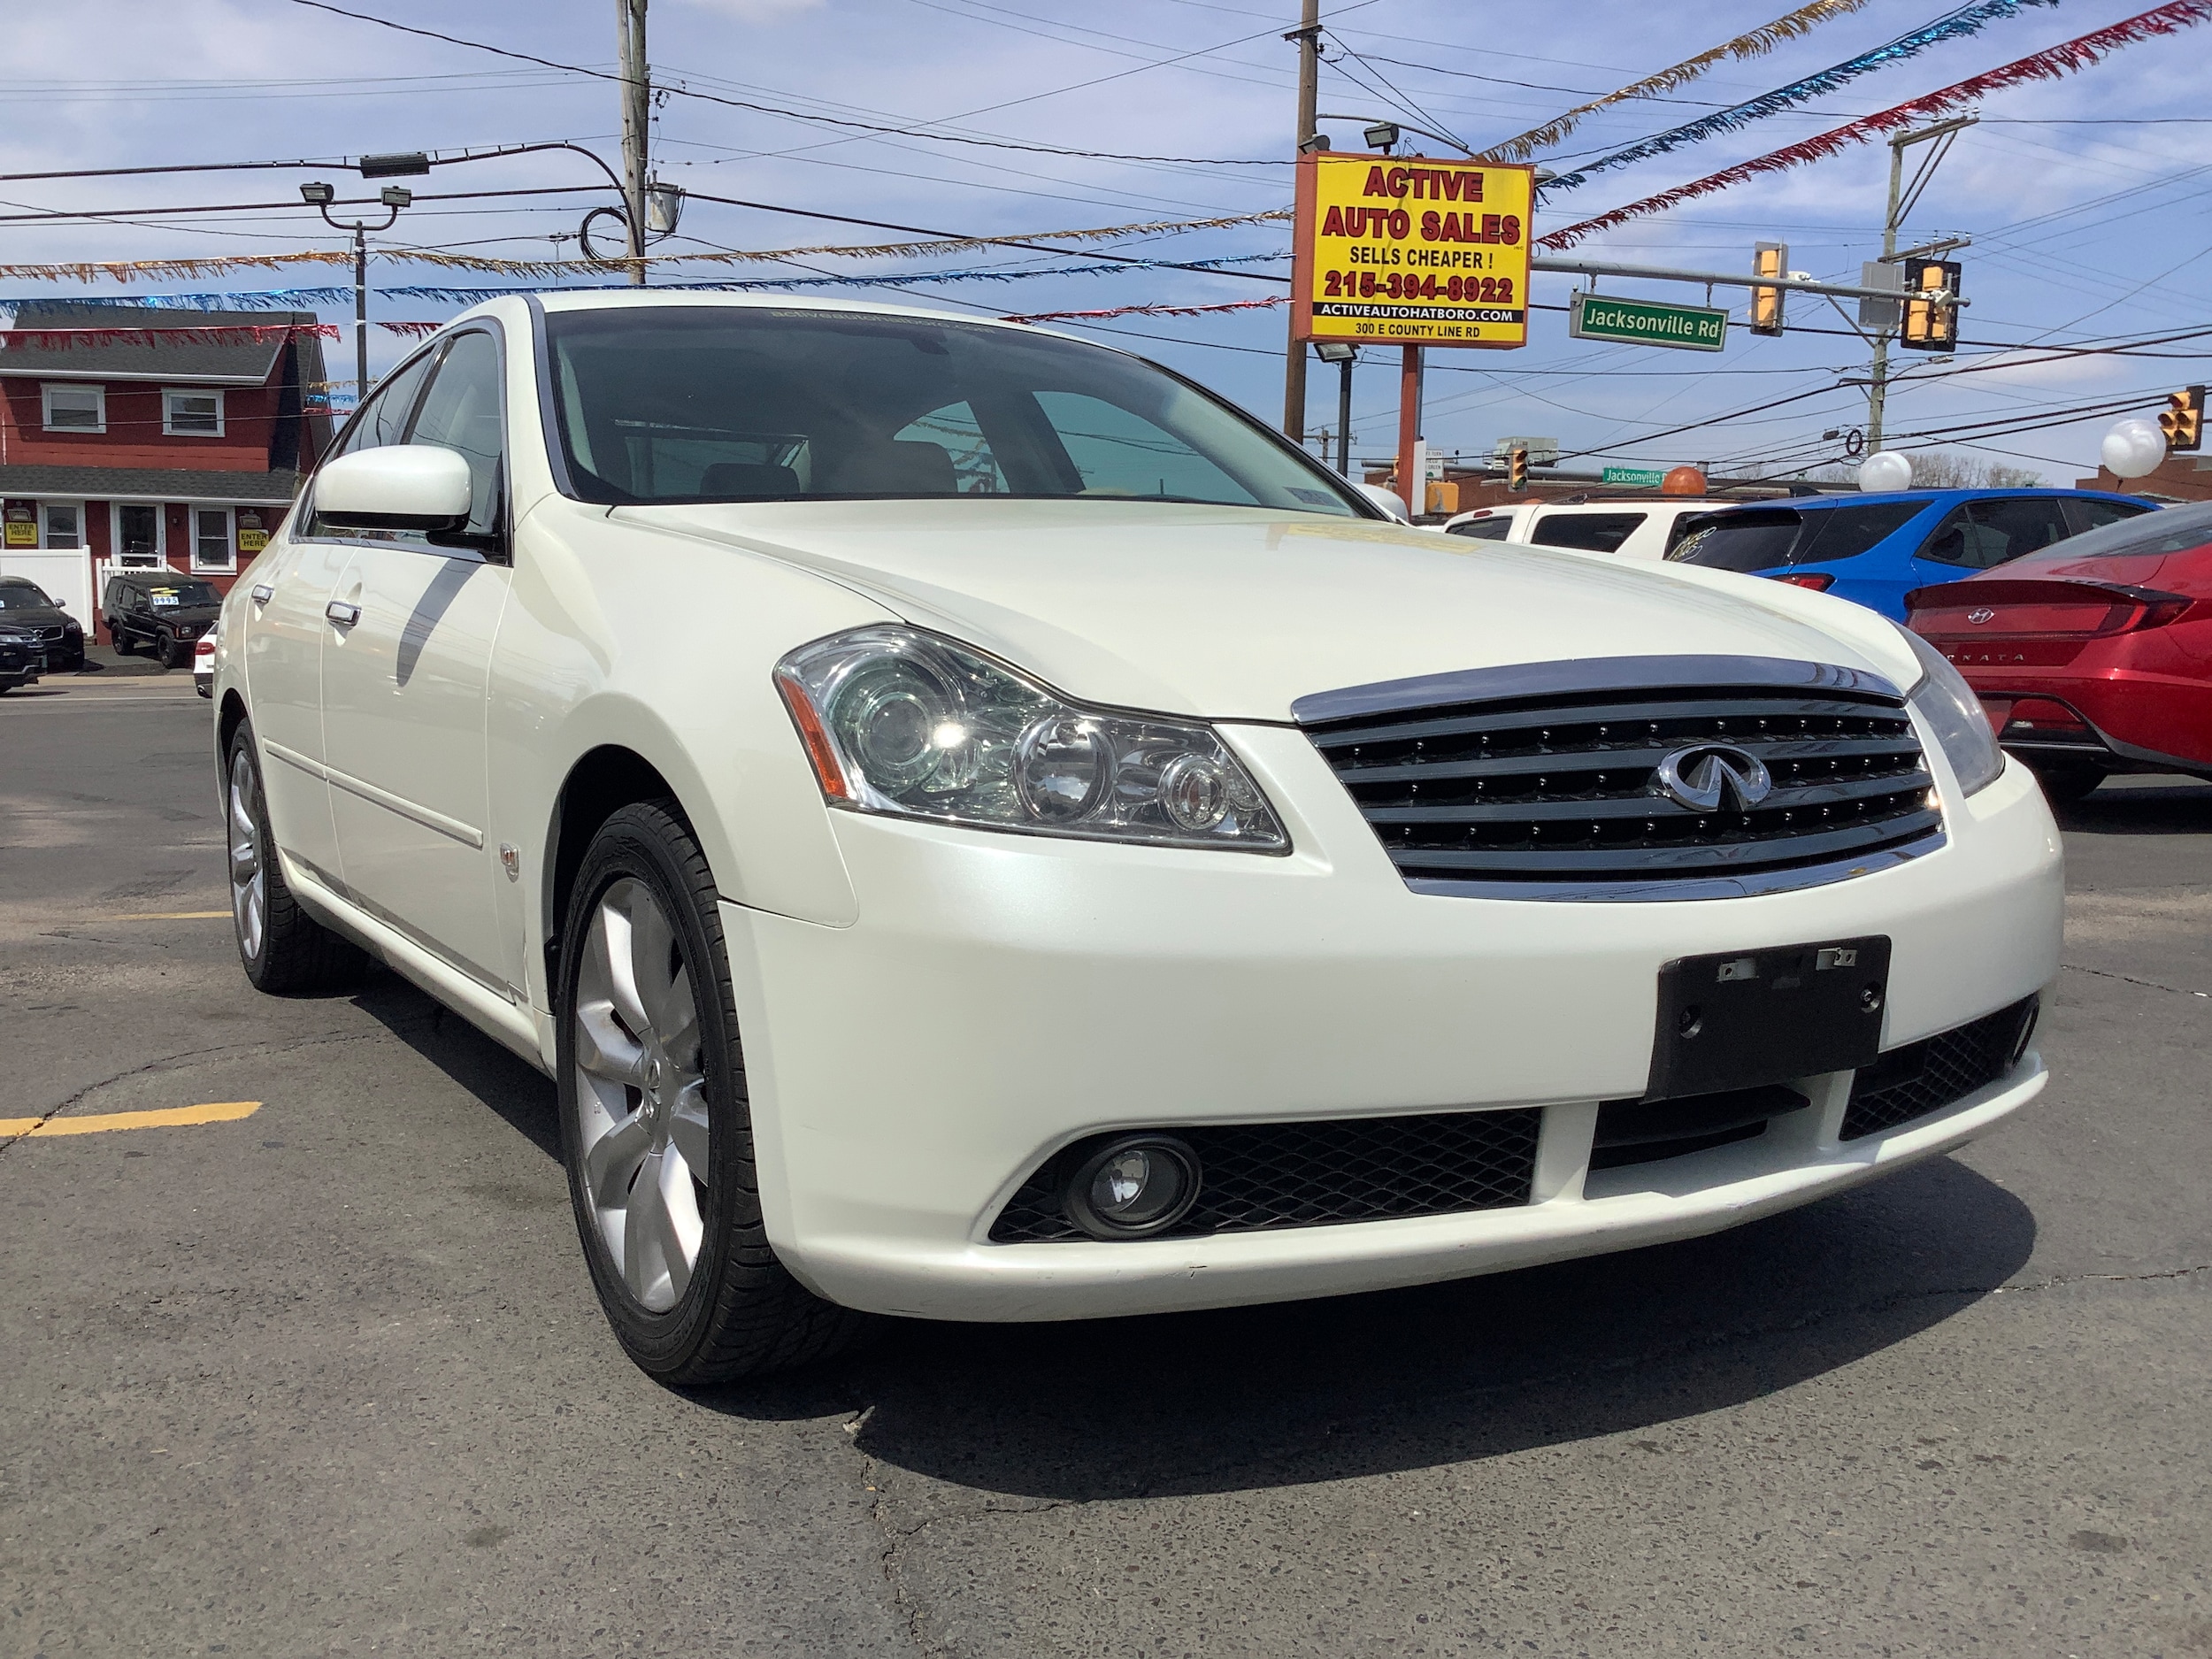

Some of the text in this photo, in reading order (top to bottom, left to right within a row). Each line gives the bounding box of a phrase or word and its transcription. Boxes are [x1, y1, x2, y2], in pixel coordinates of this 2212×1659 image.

[1363, 165, 1484, 203] ACTIVE
[1321, 205, 1520, 245] AUTO SALES
[1349, 246, 1401, 265] SELLS
[1407, 249, 1483, 269] CHEAPER
[1324, 270, 1514, 303] 215-394-8922
[1321, 304, 1513, 322] ACTIVEAUTOHATBORO.COM
[1586, 308, 1719, 339] Jacksonville Rd
[1355, 323, 1480, 338] 300 E COUNTY LINE RD
[1606, 469, 1660, 484] Jacksonville
